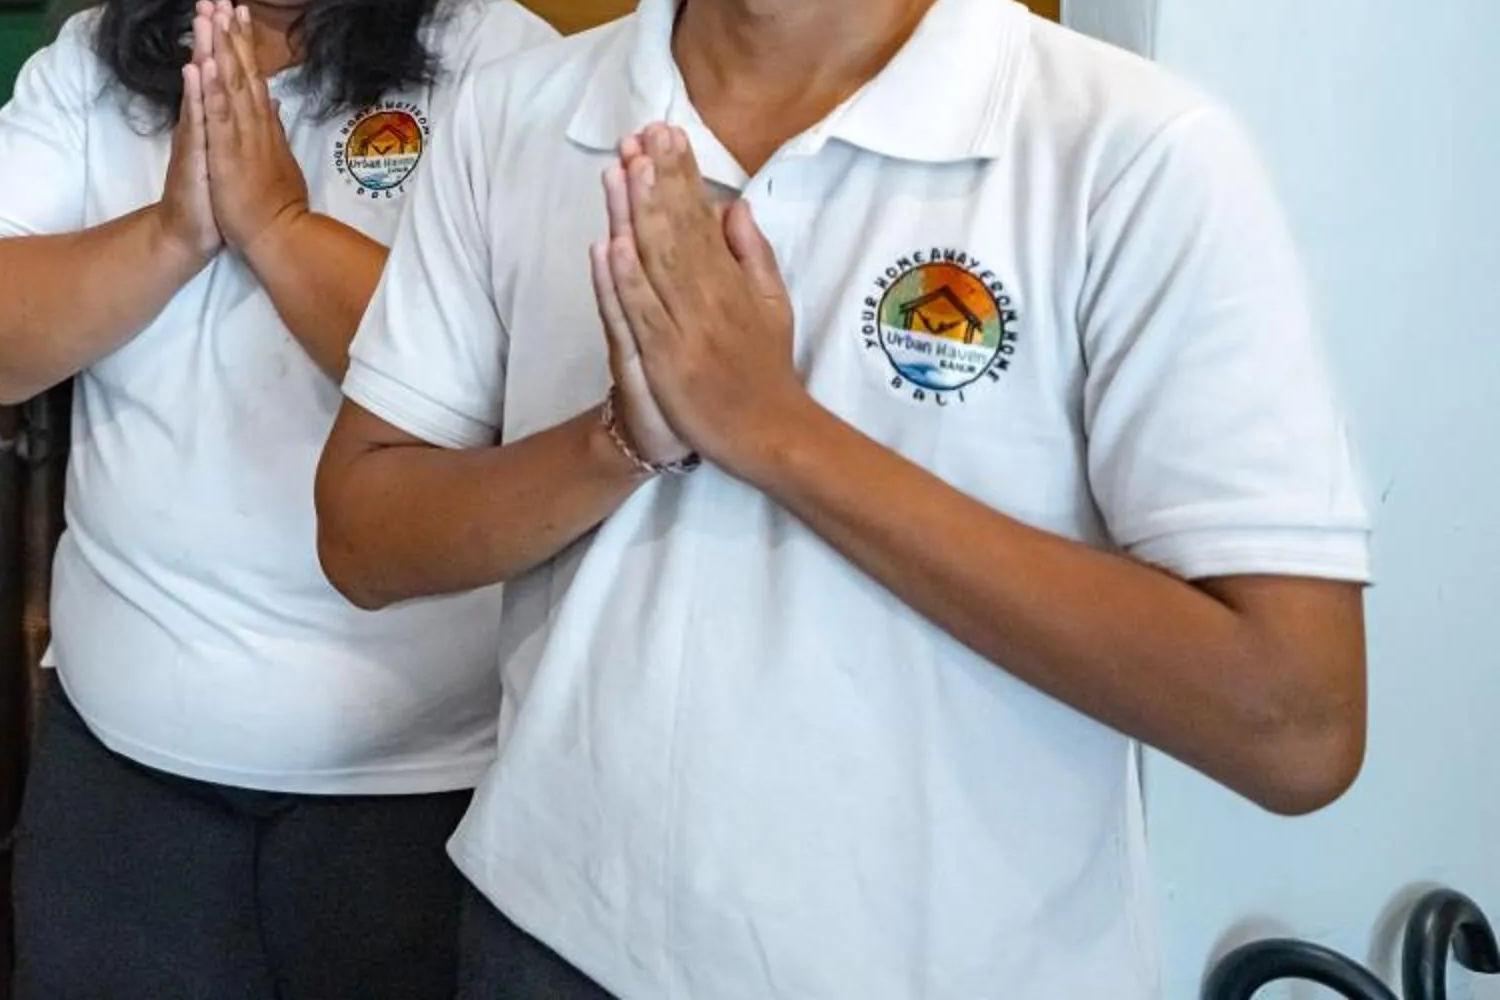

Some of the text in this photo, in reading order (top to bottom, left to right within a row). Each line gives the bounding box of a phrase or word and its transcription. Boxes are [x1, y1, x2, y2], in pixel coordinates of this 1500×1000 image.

[860, 247, 1019, 383] YOUR HOME AWAY FROM HOME
[886, 330, 989, 365] Urban Haven
[891, 375, 965, 407] BALI
